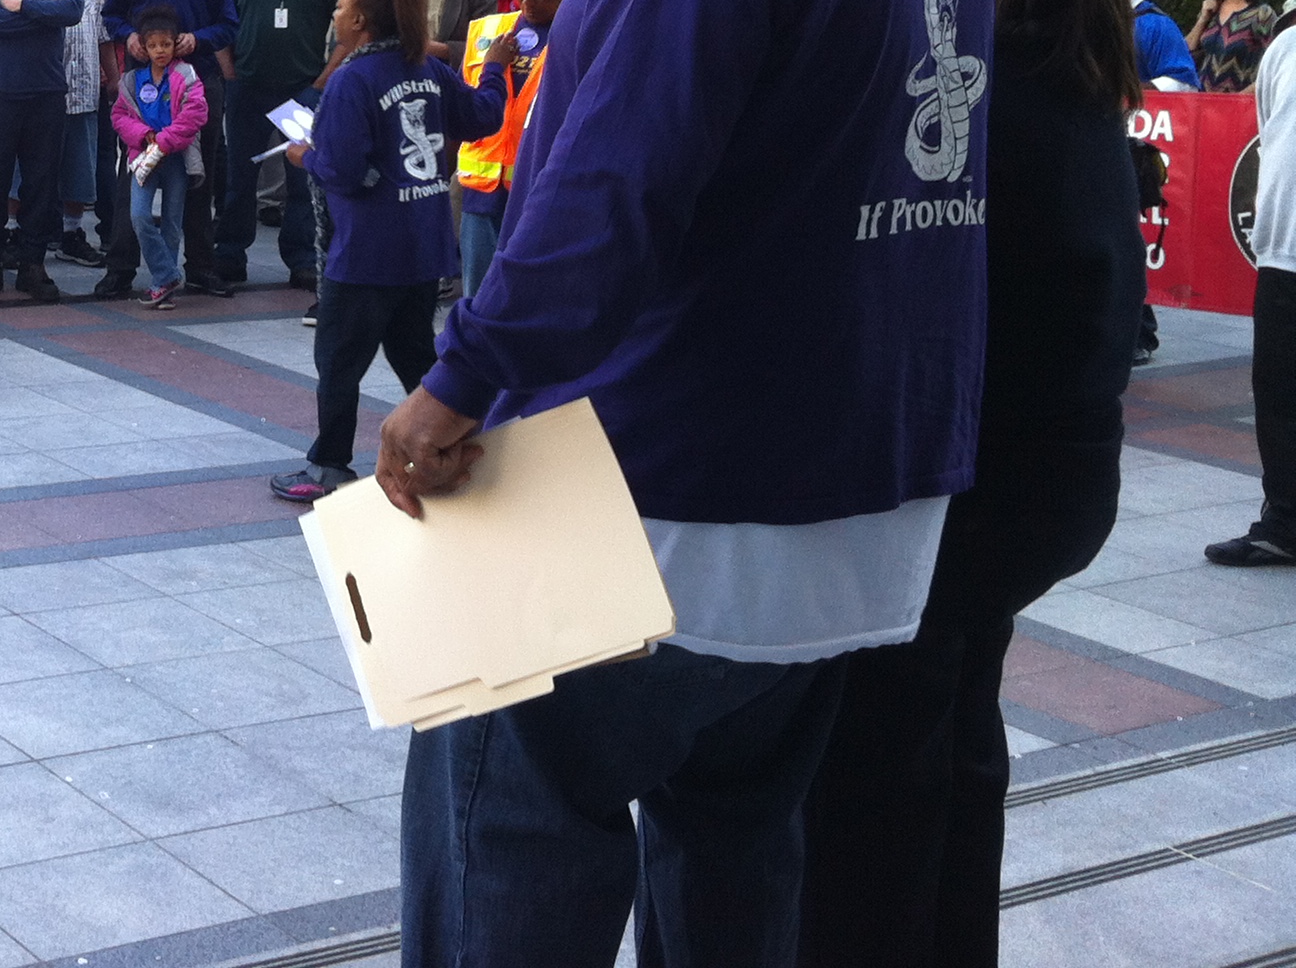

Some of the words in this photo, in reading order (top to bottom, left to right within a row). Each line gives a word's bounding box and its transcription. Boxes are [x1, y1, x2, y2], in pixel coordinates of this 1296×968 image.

[379, 84, 404, 111] Will
[398, 186, 411, 202] If
[855, 201, 886, 241] If
